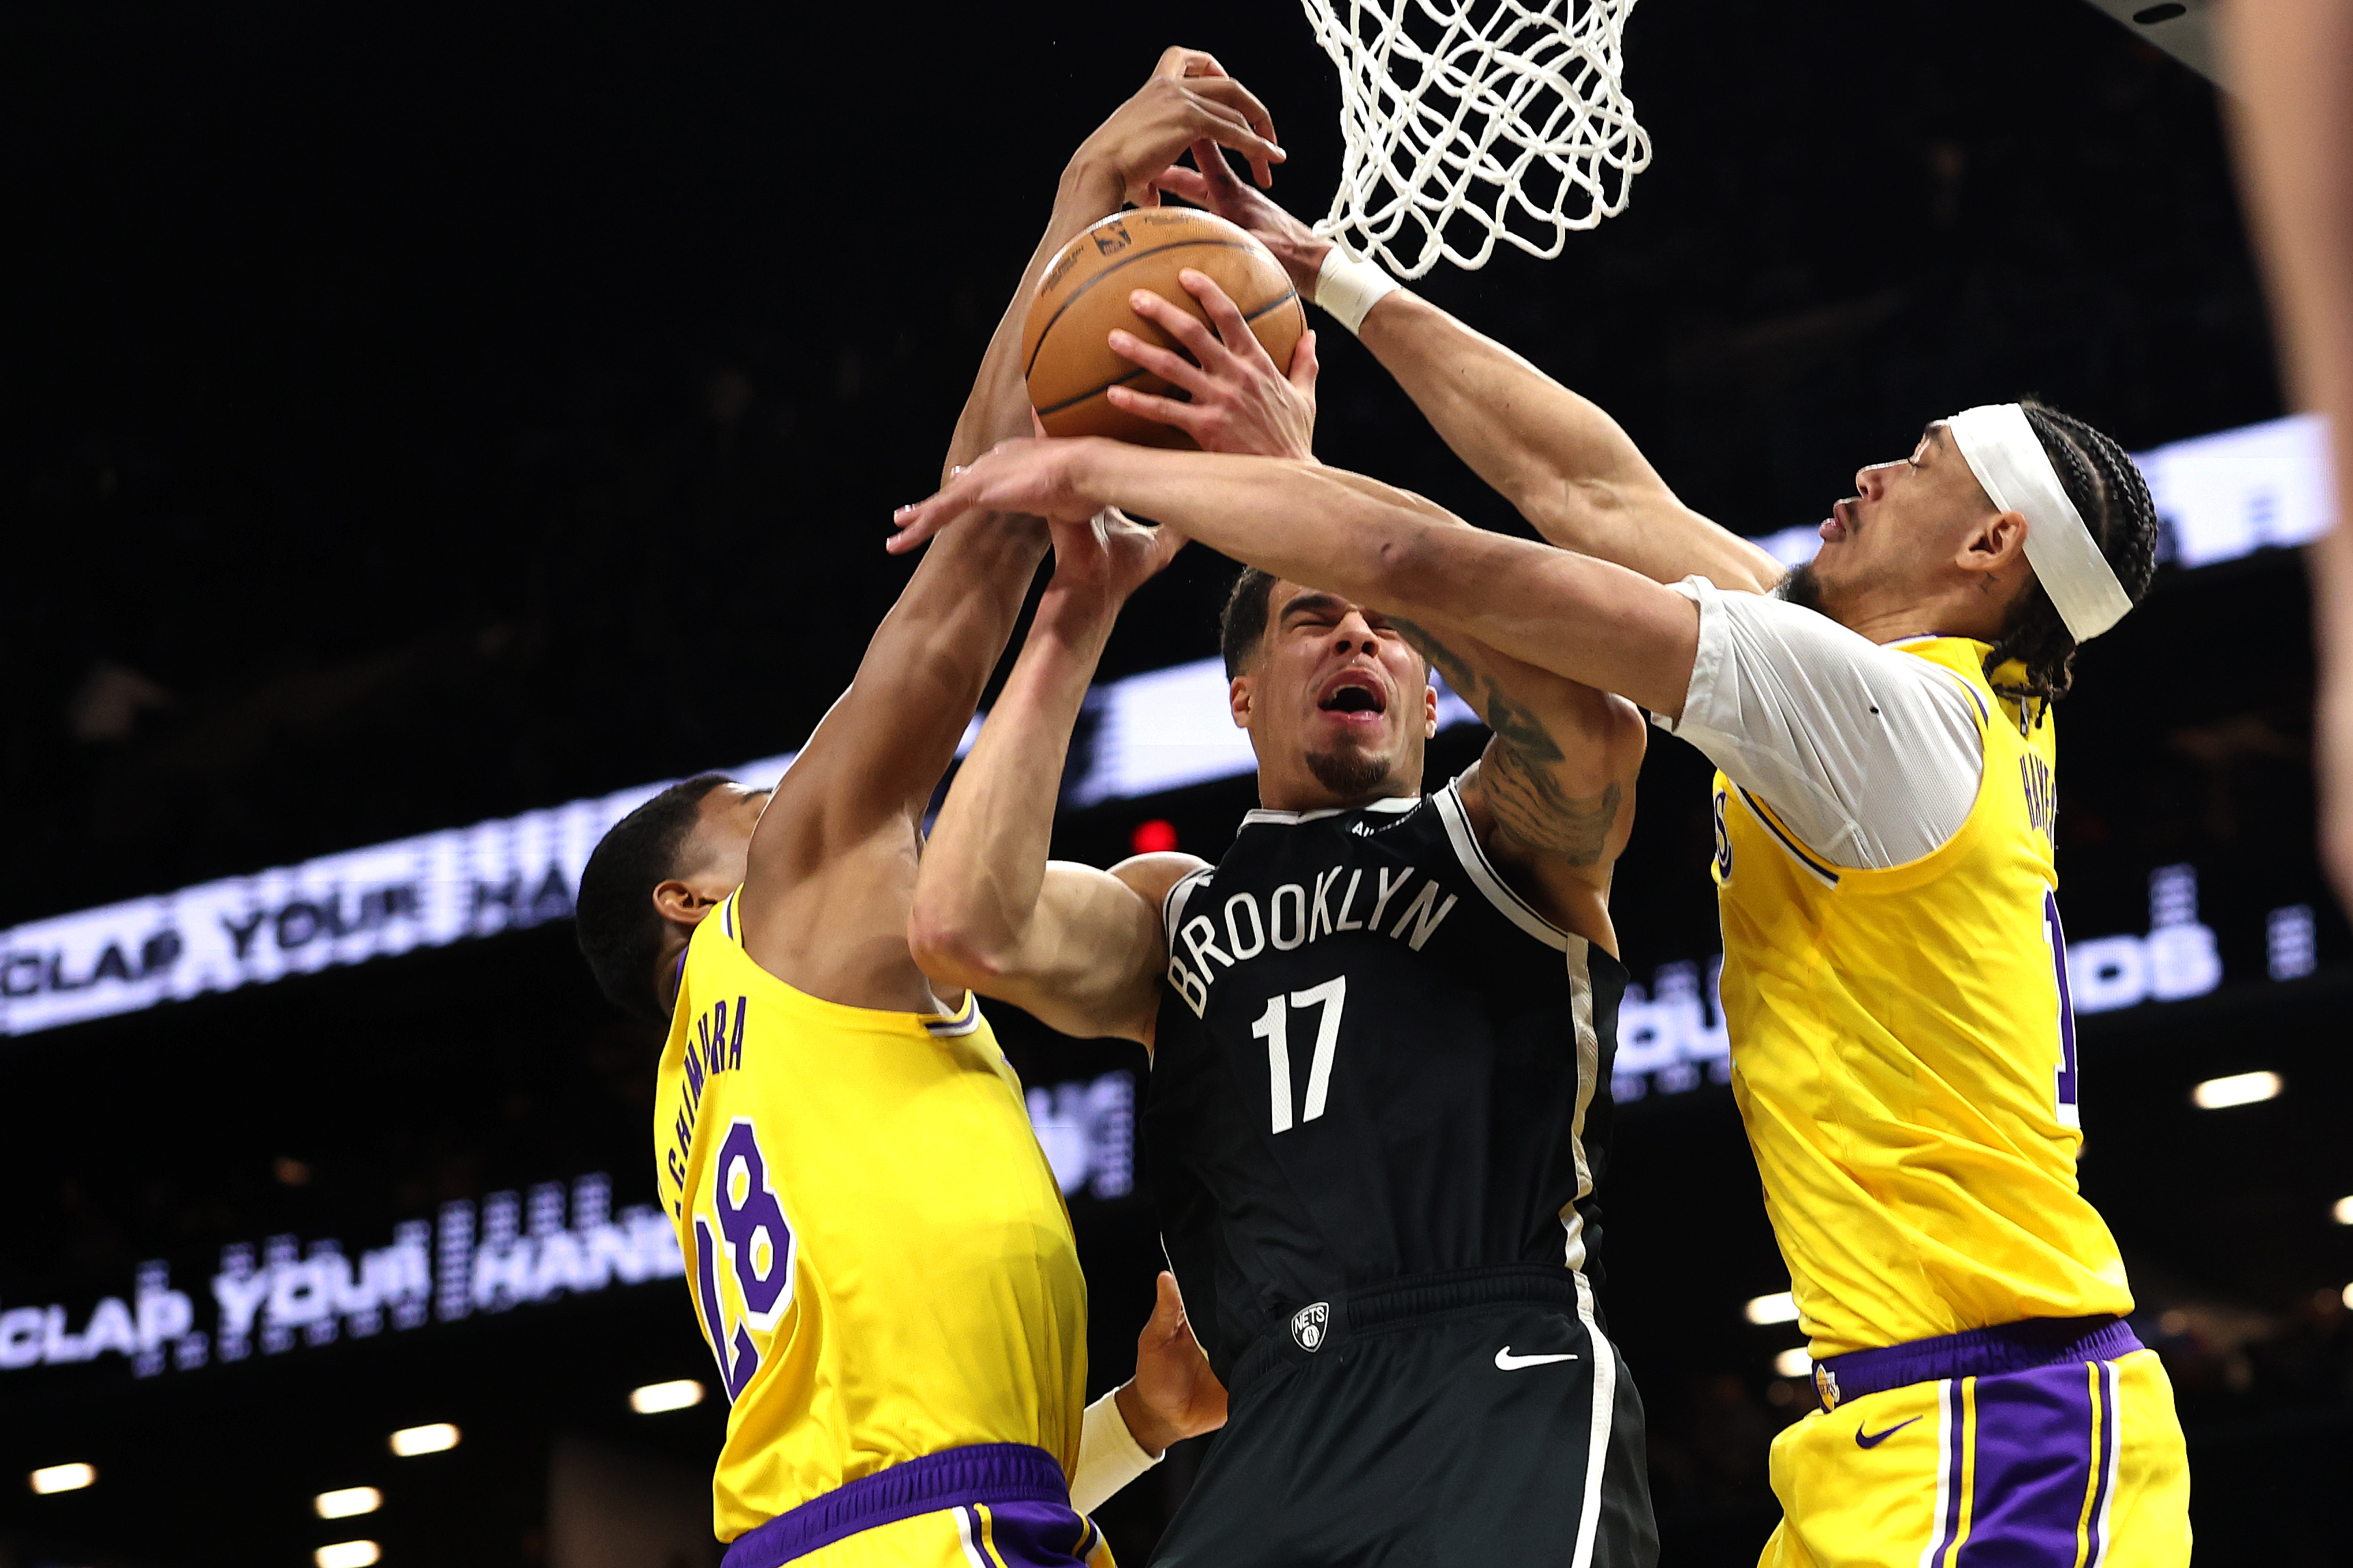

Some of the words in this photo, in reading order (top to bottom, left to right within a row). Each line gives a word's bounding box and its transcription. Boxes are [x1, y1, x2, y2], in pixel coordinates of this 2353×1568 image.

[0, 928, 184, 997] CLAP
[1167, 865, 1459, 1020] BROOKLYN
[668, 995, 747, 1222] CHIMURA
[1251, 974, 1347, 1135] 17
[0, 1290, 194, 1369] CLAP
[1294, 1305, 1325, 1335] NETS
